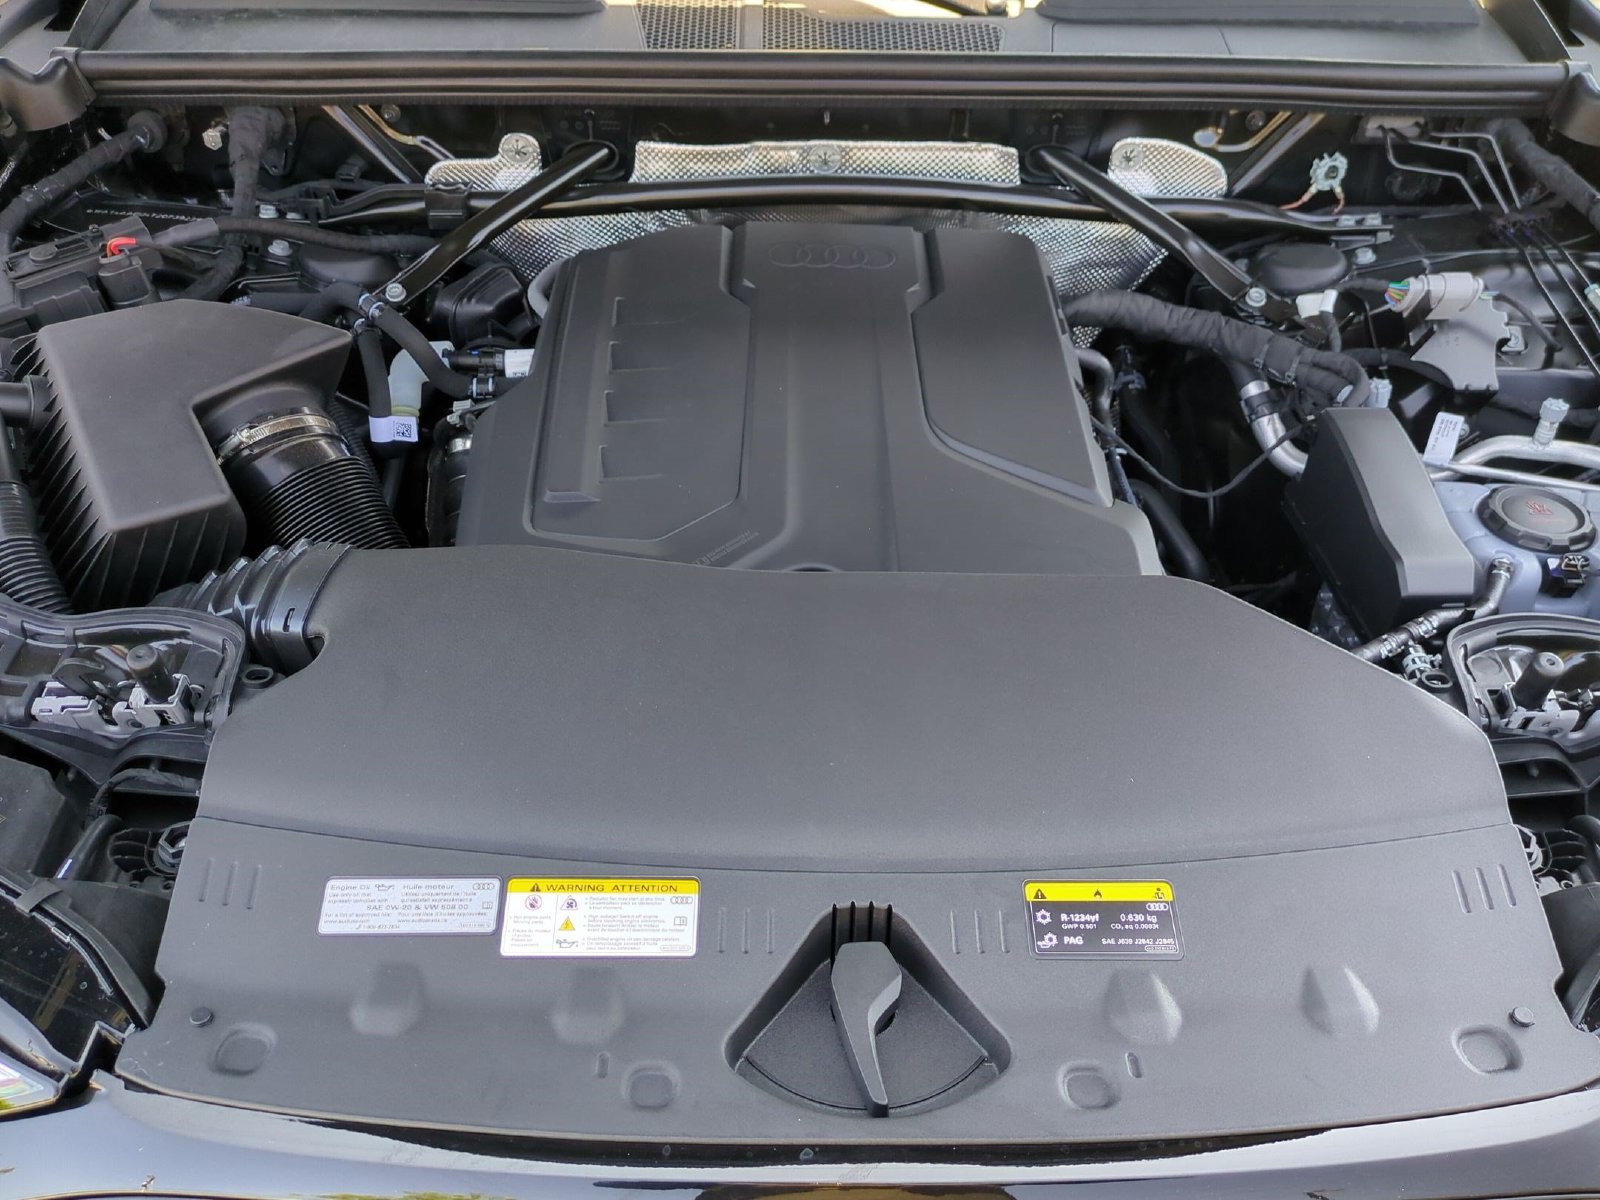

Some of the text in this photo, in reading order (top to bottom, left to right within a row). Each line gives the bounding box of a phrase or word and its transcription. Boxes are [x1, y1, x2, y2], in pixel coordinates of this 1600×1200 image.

[546, 884, 678, 892] WARNING ATTENTION
[1060, 914, 1100, 923] R-1234yf
[1120, 914, 1158, 924] 0.630 kg
[1064, 936, 1084, 944] PAG
